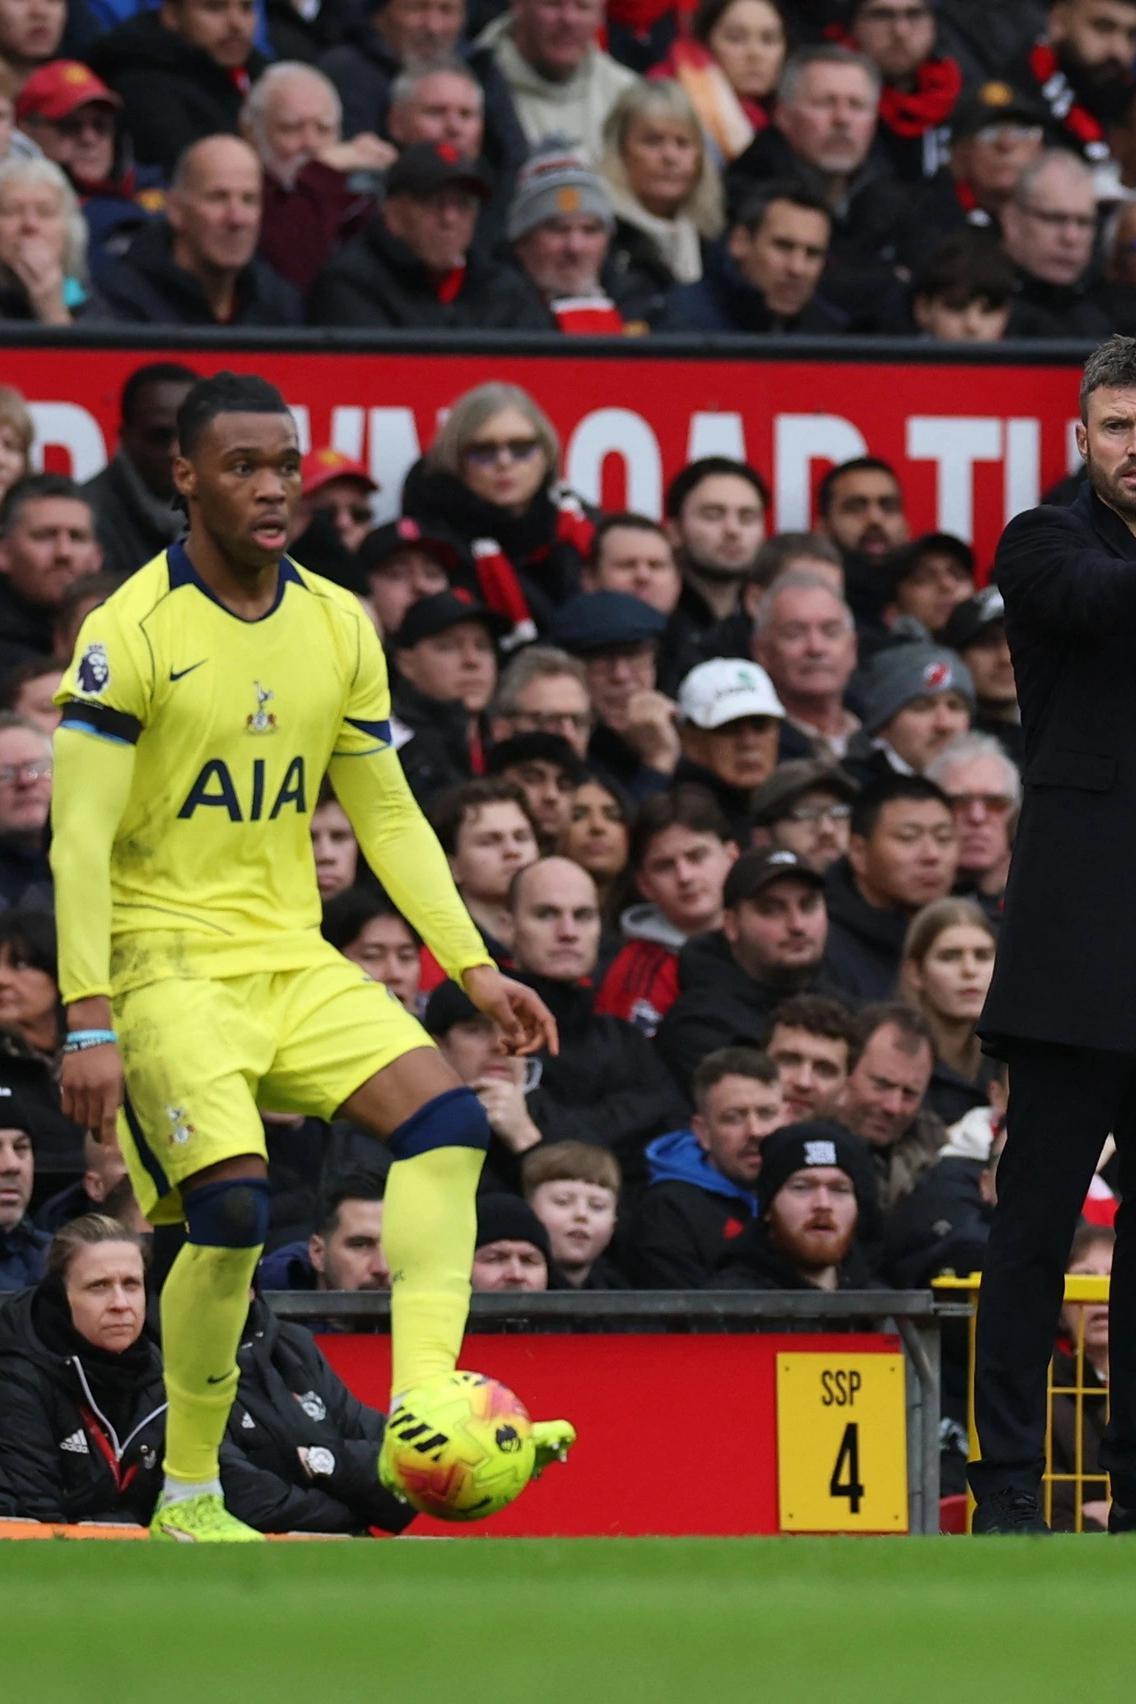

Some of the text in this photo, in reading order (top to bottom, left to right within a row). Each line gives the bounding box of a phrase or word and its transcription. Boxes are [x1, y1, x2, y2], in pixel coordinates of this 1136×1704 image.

[177, 756, 307, 822] AIA
[821, 1369, 861, 1406] SSP
[830, 1422, 865, 1514] 4
